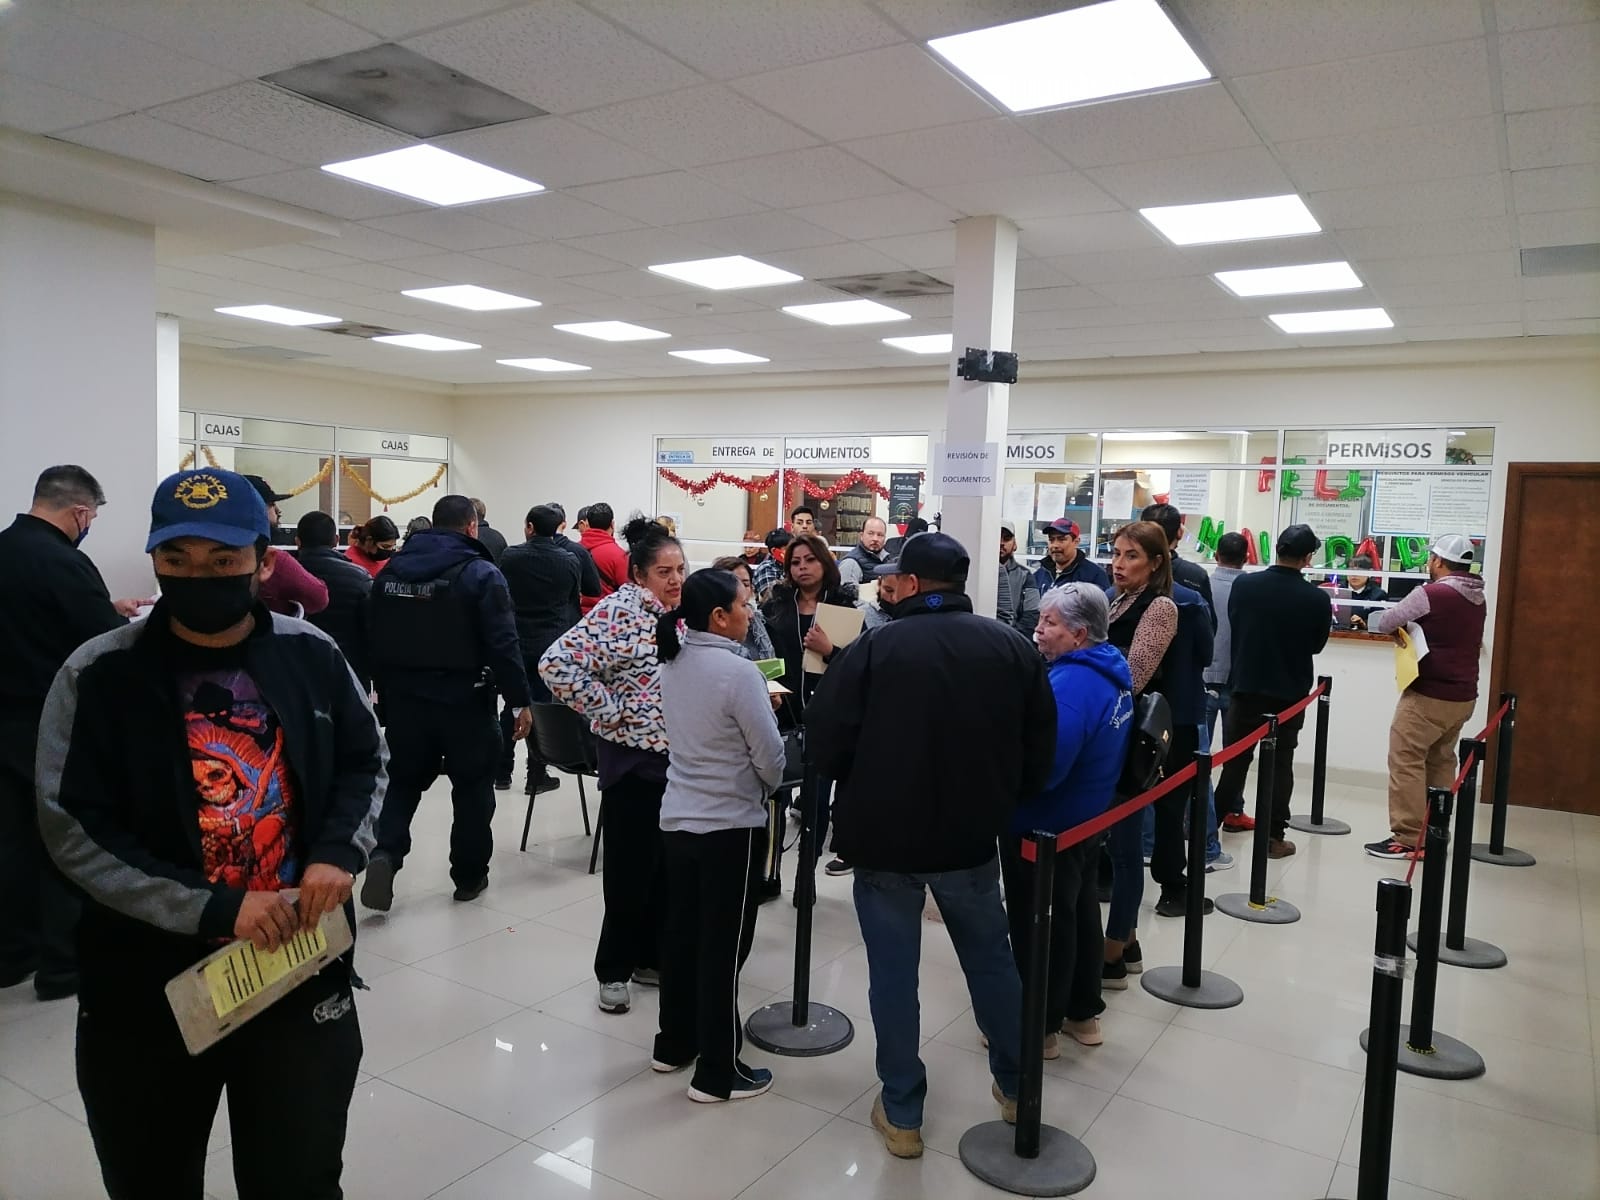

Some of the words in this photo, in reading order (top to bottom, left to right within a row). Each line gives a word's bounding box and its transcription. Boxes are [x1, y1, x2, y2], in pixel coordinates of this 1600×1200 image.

[205, 423, 241, 436] CAJAS
[381, 439, 409, 451] CAJAS
[1328, 442, 1432, 459] PERMISOS
[712, 446, 756, 457] ENTREGA
[763, 447, 774, 457] DE
[785, 446, 870, 459] DOCUMENTOS
[1006, 445, 1055, 459] MISOS
[942, 475, 991, 483] DOCUMENTOS
